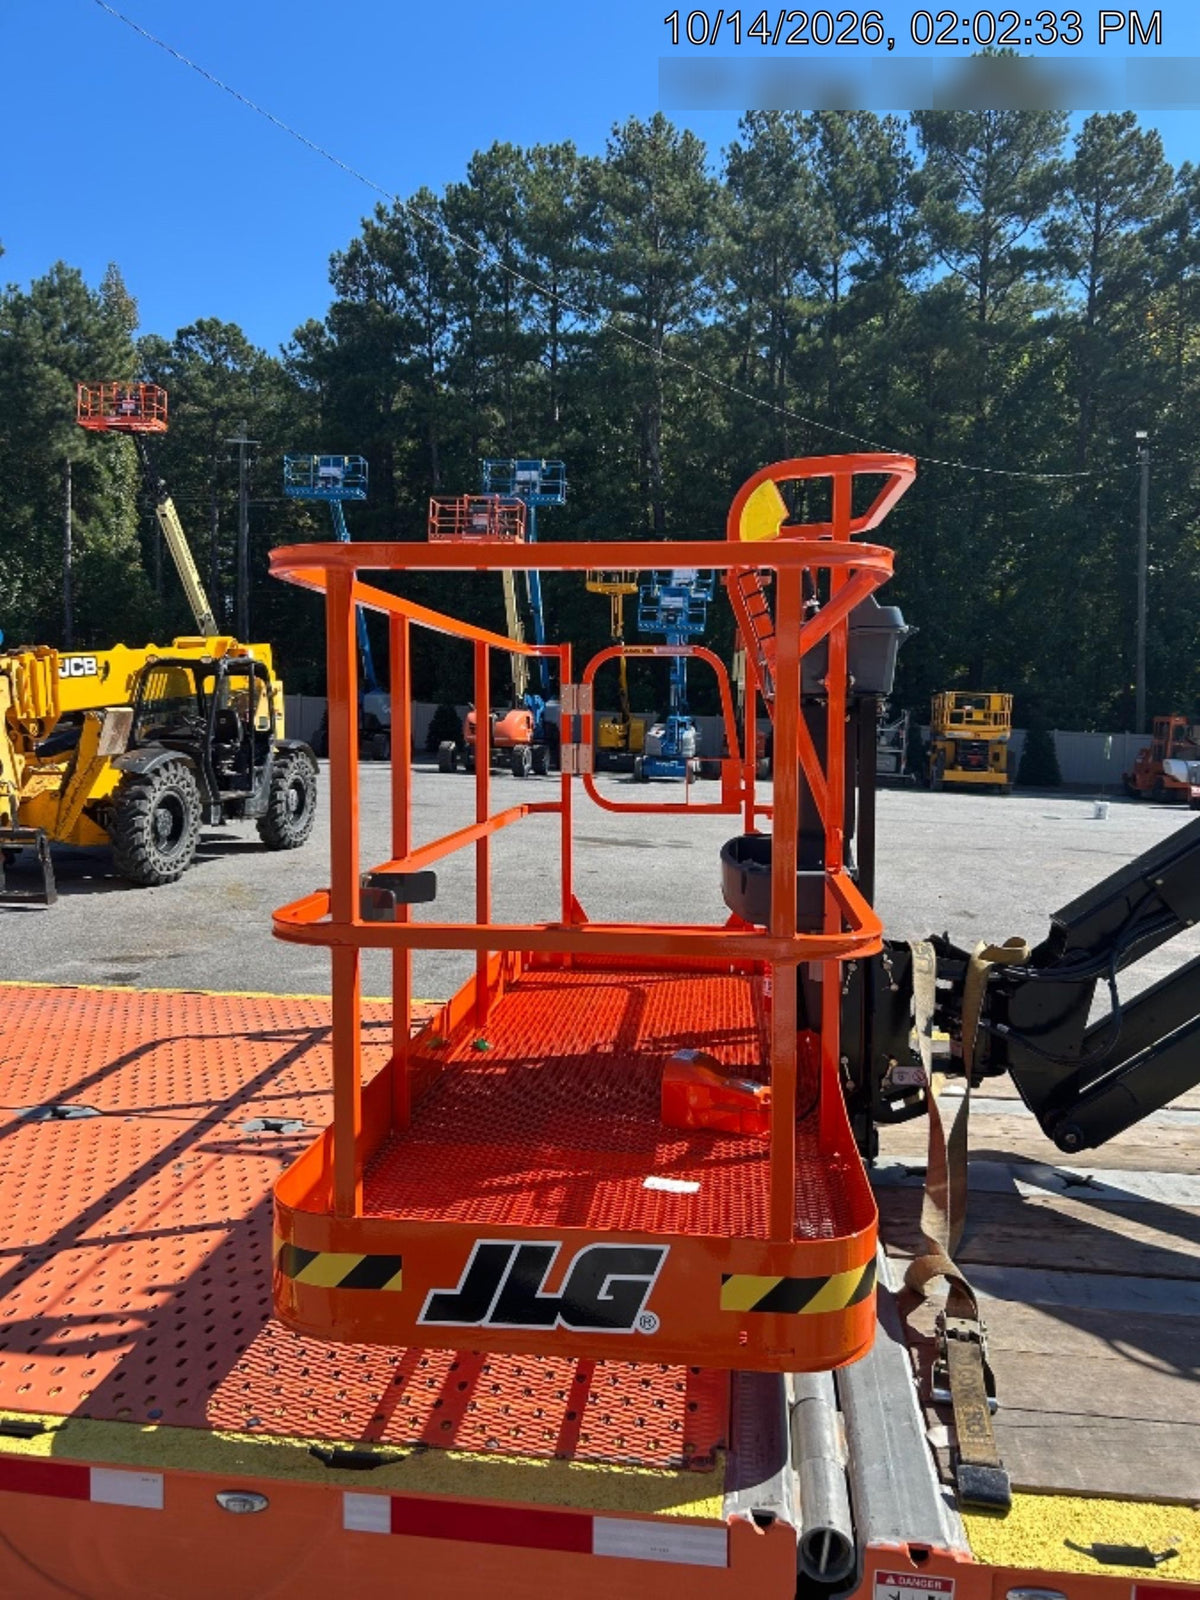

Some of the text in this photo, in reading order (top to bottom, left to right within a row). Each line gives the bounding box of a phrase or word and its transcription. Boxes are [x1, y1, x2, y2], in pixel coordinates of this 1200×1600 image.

[58, 656, 97, 678] JCB
[416, 1239, 671, 1335] JLG
[897, 1576, 943, 1590] DANGER
